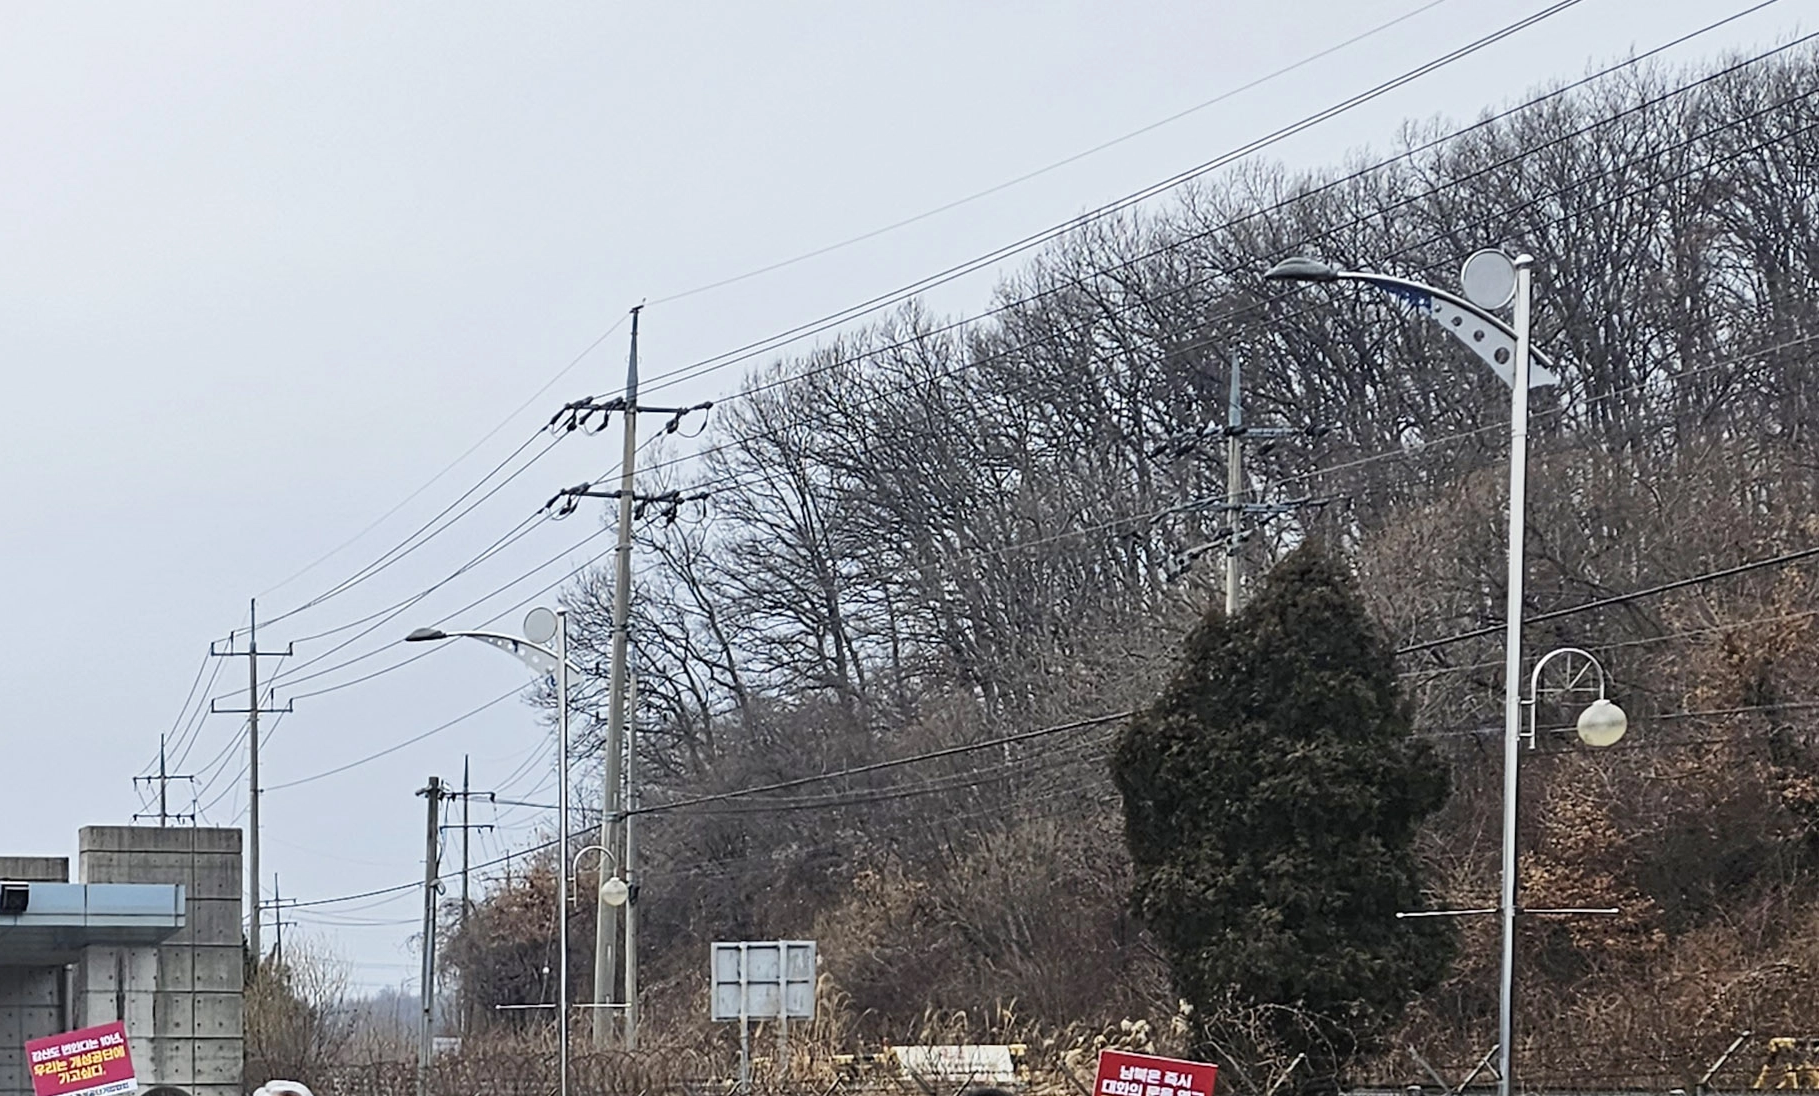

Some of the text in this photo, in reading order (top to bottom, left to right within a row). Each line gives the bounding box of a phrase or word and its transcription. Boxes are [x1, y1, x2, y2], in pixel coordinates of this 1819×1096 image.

[34, 1045, 126, 1076] 우리는 개성공단에
[58, 1064, 107, 1084] 가고싶다.
[1119, 1065, 1192, 1089] 남북은 즉시
